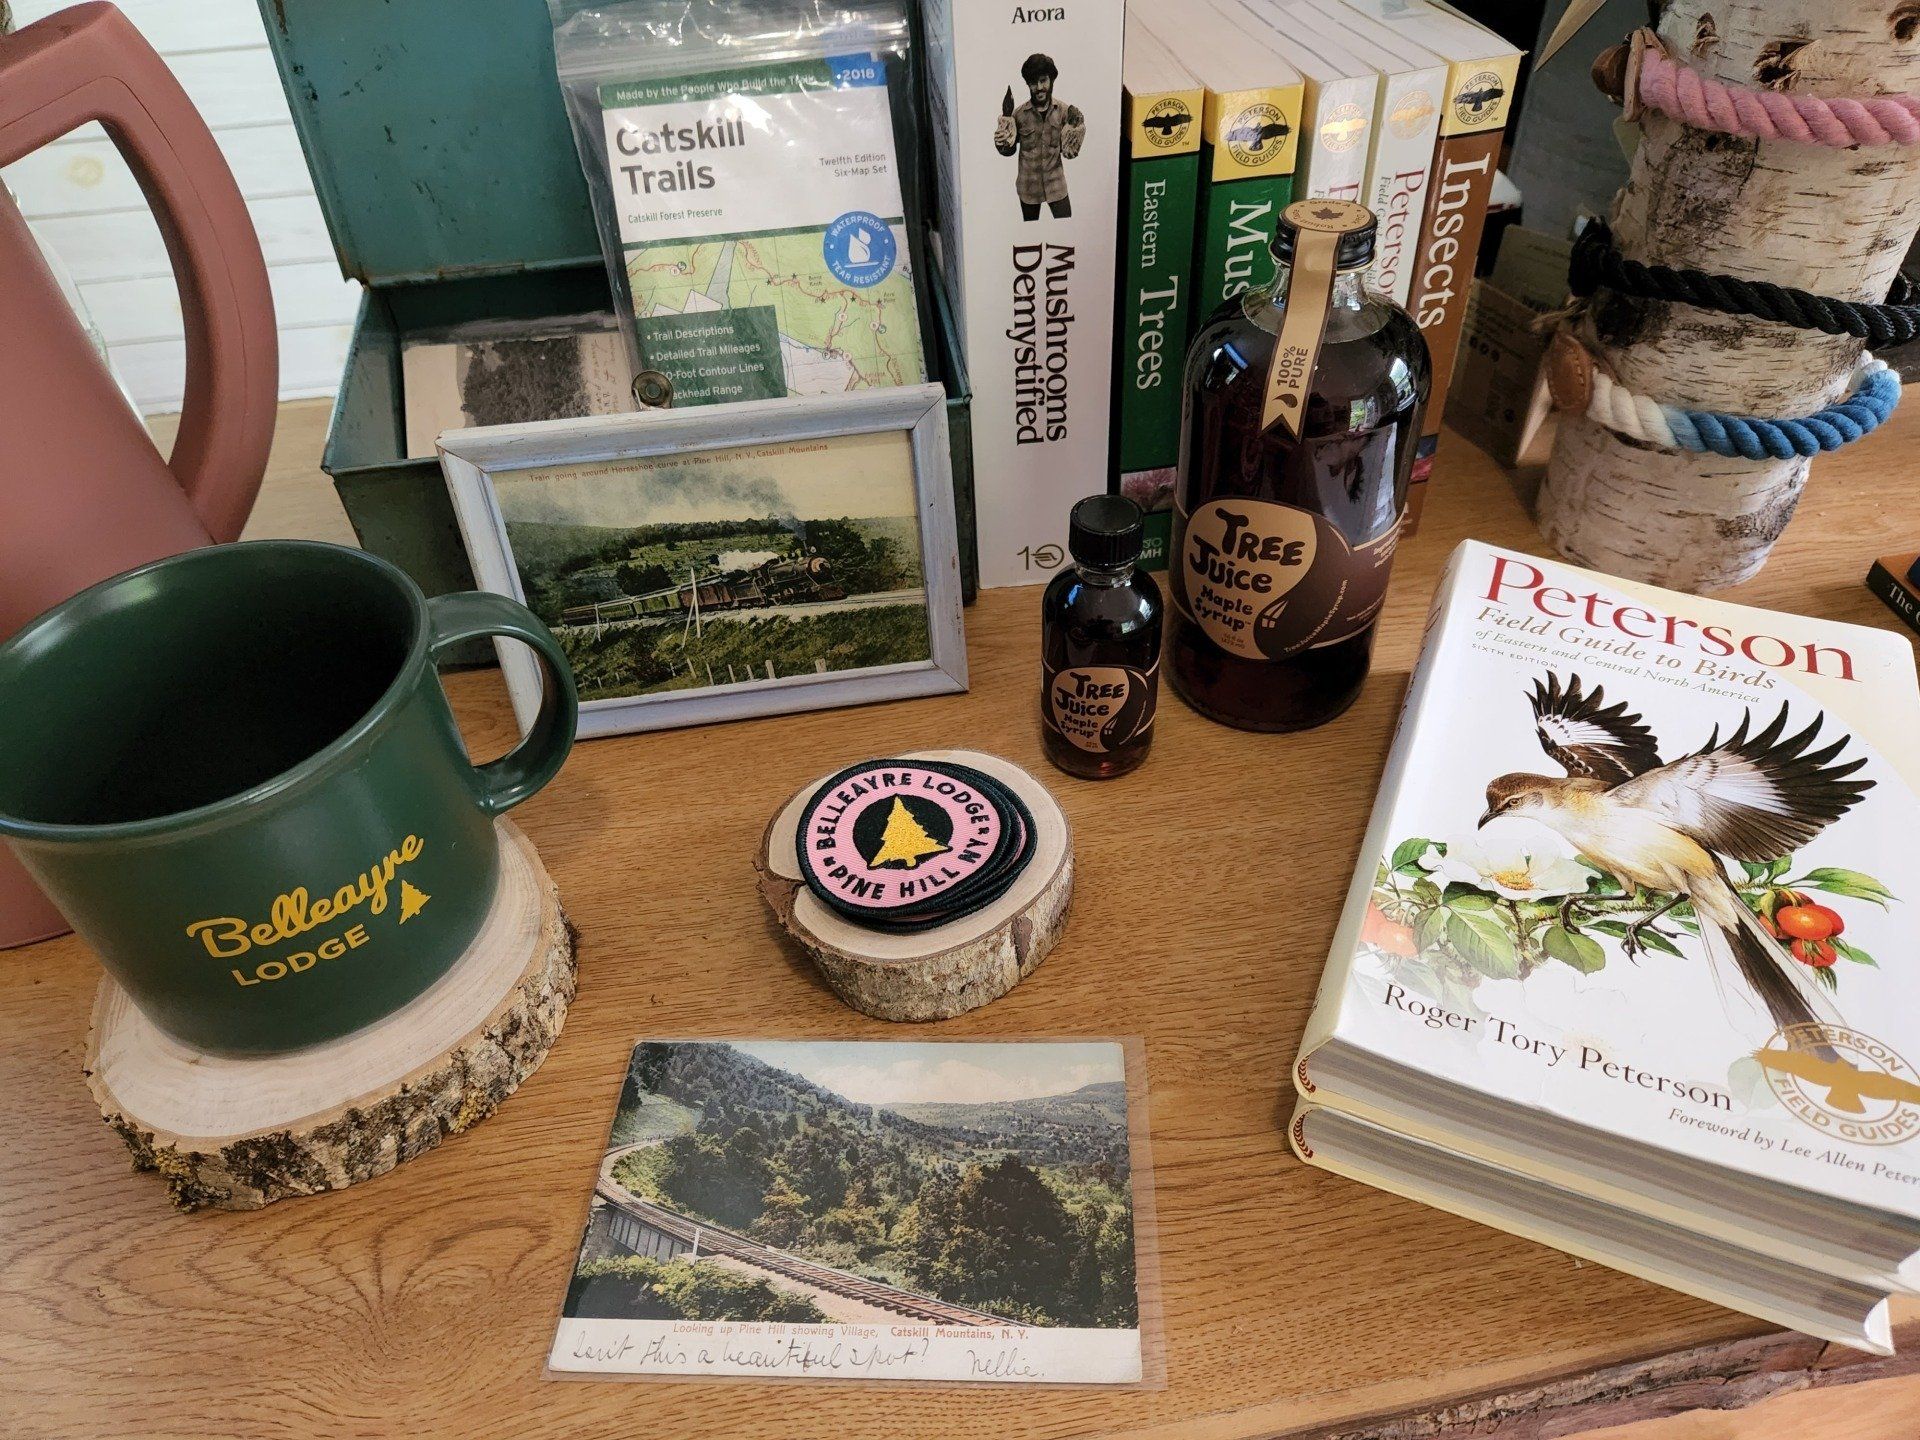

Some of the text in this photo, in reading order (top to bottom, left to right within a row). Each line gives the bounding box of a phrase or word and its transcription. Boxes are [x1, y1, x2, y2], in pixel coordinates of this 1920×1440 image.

[1012, 6, 1065, 24] Arora
[616, 90, 644, 101] Made
[647, 88, 659, 99] by
[661, 85, 678, 95] the
[680, 82, 715, 95] People
[717, 81, 740, 91] Who
[742, 77, 767, 89] Build
[769, 75, 786, 87] the
[842, 68, 875, 81] 2018
[1465, 74, 1500, 90] PETERSON
[1151, 100, 1186, 115] PETERSON
[1237, 106, 1281, 124] PETERSON
[1458, 106, 1471, 123] FIELD
[616, 112, 746, 156] Catskill
[1147, 129, 1163, 145] FIELD
[819, 153, 886, 166] Twelfth Edition
[1231, 139, 1282, 164] FIELD GUIDES
[620, 160, 716, 195] Trails
[834, 165, 888, 178] Six-Map Set
[628, 207, 723, 224] Catskill Forest Preserve
[831, 215, 885, 237] WATERPROOF
[1416, 153, 1491, 331] Insects
[832, 260, 852, 281] TEAR
[853, 255, 891, 284] RESISTANT
[1136, 178, 1179, 391] Eastern Trees
[653, 325, 735, 342] Trail Descriptions
[1006, 242, 1045, 447] Demystified
[1045, 242, 1076, 442] Mushrooms
[656, 342, 761, 362] Detailed Trail Mileages
[1277, 345, 1296, 387] 100%
[661, 362, 765, 382] 0-Foot Contour Lines
[1288, 347, 1309, 389] PURE
[673, 384, 743, 400] ackhead Range
[529, 474, 550, 483] Train
[554, 471, 578, 483] going
[581, 467, 609, 478] around
[611, 463, 654, 475] Horseshoe
[657, 461, 679, 470] curve
[682, 459, 691, 467] at
[757, 449, 785, 459] Catskill
[788, 443, 829, 455] Mountains
[1200, 585, 1253, 616] Maple
[1889, 582, 1913, 614] The
[1478, 554, 1863, 683] Peterson
[1472, 643, 1558, 669] SIXTH EDITION
[1476, 606, 1776, 690] Field Guide to Birds
[1475, 630, 1761, 704] of Eastern and Central North America
[1064, 714, 1098, 729] Maple
[817, 773, 990, 850] BELLEAYRE LODGE
[186, 834, 424, 958] Belleayre
[828, 865, 885, 900] PINE
[900, 867, 961, 898] HILL
[231, 923, 370, 987] LODGE
[1382, 983, 1733, 1112] Roger Tory Peterson
[1772, 1075, 1920, 1141] FIELD GUIDES
[1668, 1107, 1920, 1185] Foreword by Lee Allen Peter
[673, 1323, 1028, 1340] Looking up Pine Hill showing Village, Catskill Mountains, N. Y.
[698, 1349, 714, 1364] a
